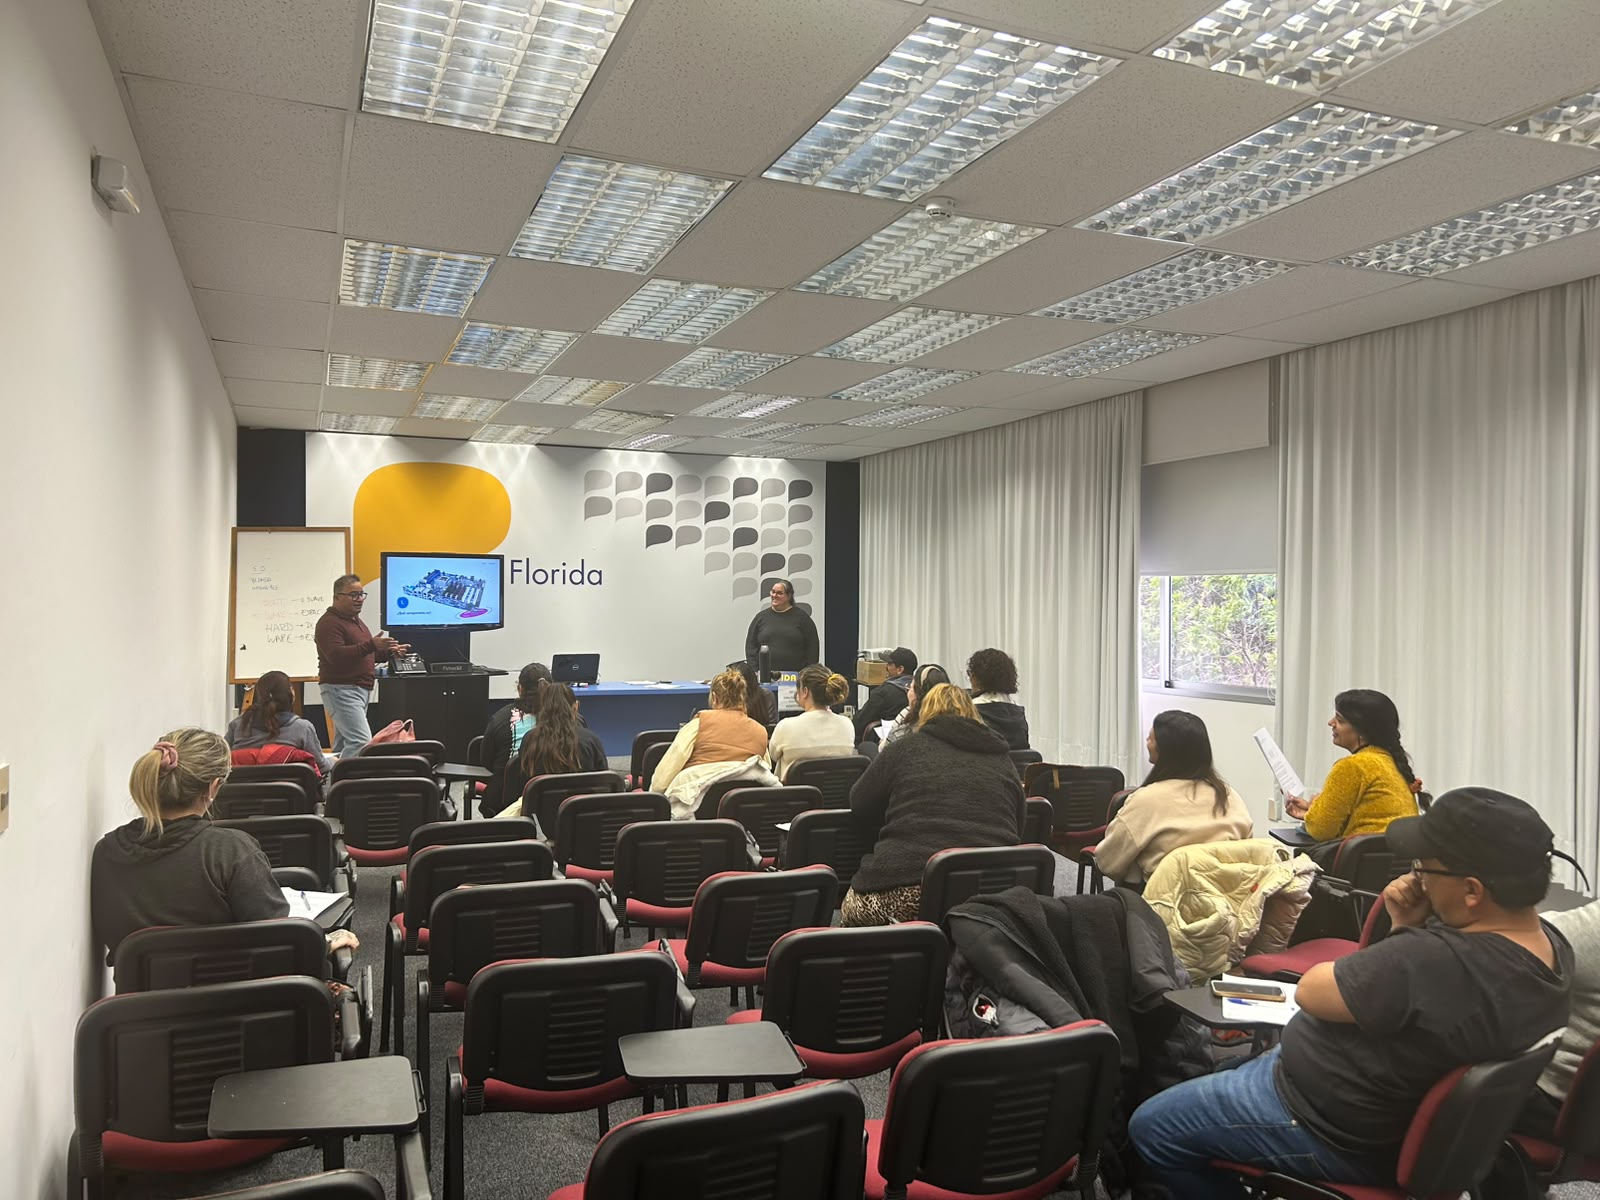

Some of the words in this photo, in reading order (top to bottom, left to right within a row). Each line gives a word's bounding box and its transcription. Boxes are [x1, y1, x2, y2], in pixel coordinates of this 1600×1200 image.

[510, 557, 603, 586] Florida
[265, 622, 294, 632] HARD
[781, 674, 797, 682] IDA
